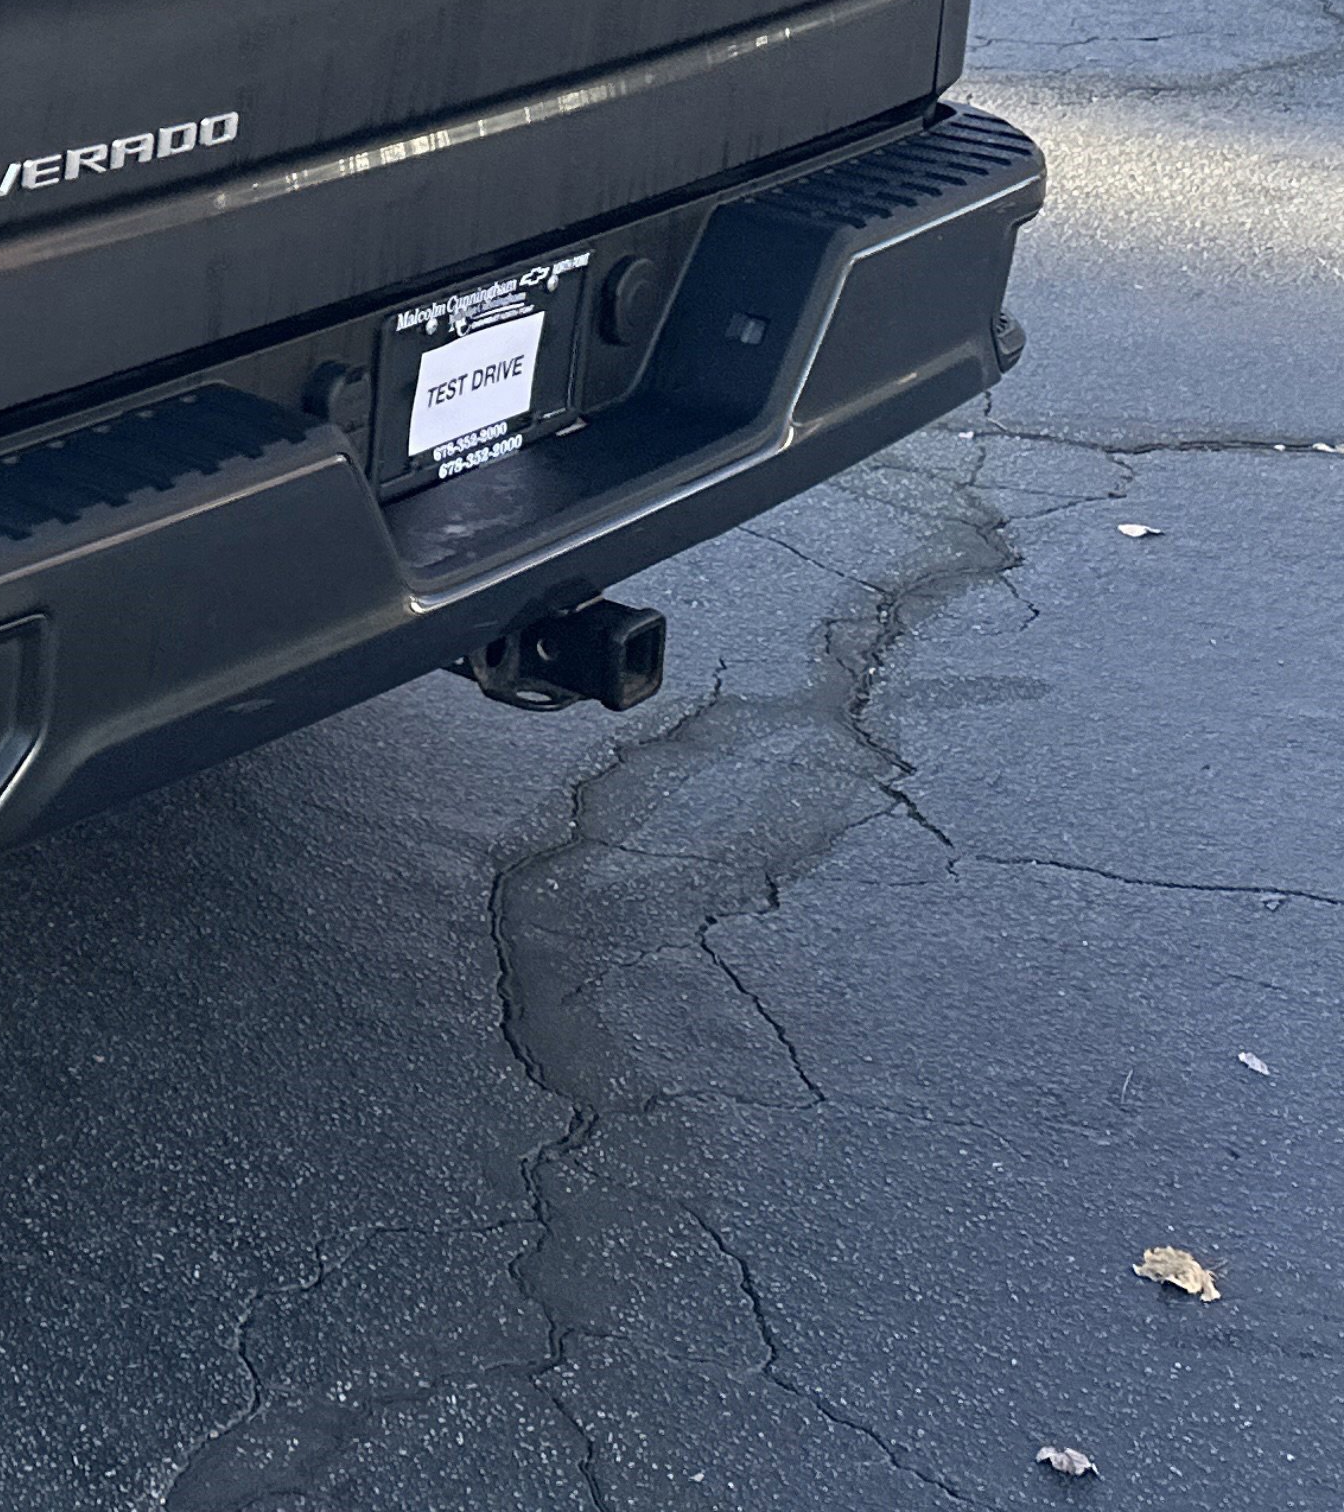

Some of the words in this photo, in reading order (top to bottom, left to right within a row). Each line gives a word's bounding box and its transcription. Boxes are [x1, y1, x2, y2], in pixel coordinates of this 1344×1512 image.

[395, 302, 447, 332] Malcolm
[446, 278, 517, 314] Cunningham
[427, 373, 469, 408] TEST
[471, 354, 525, 391] DRIVE
